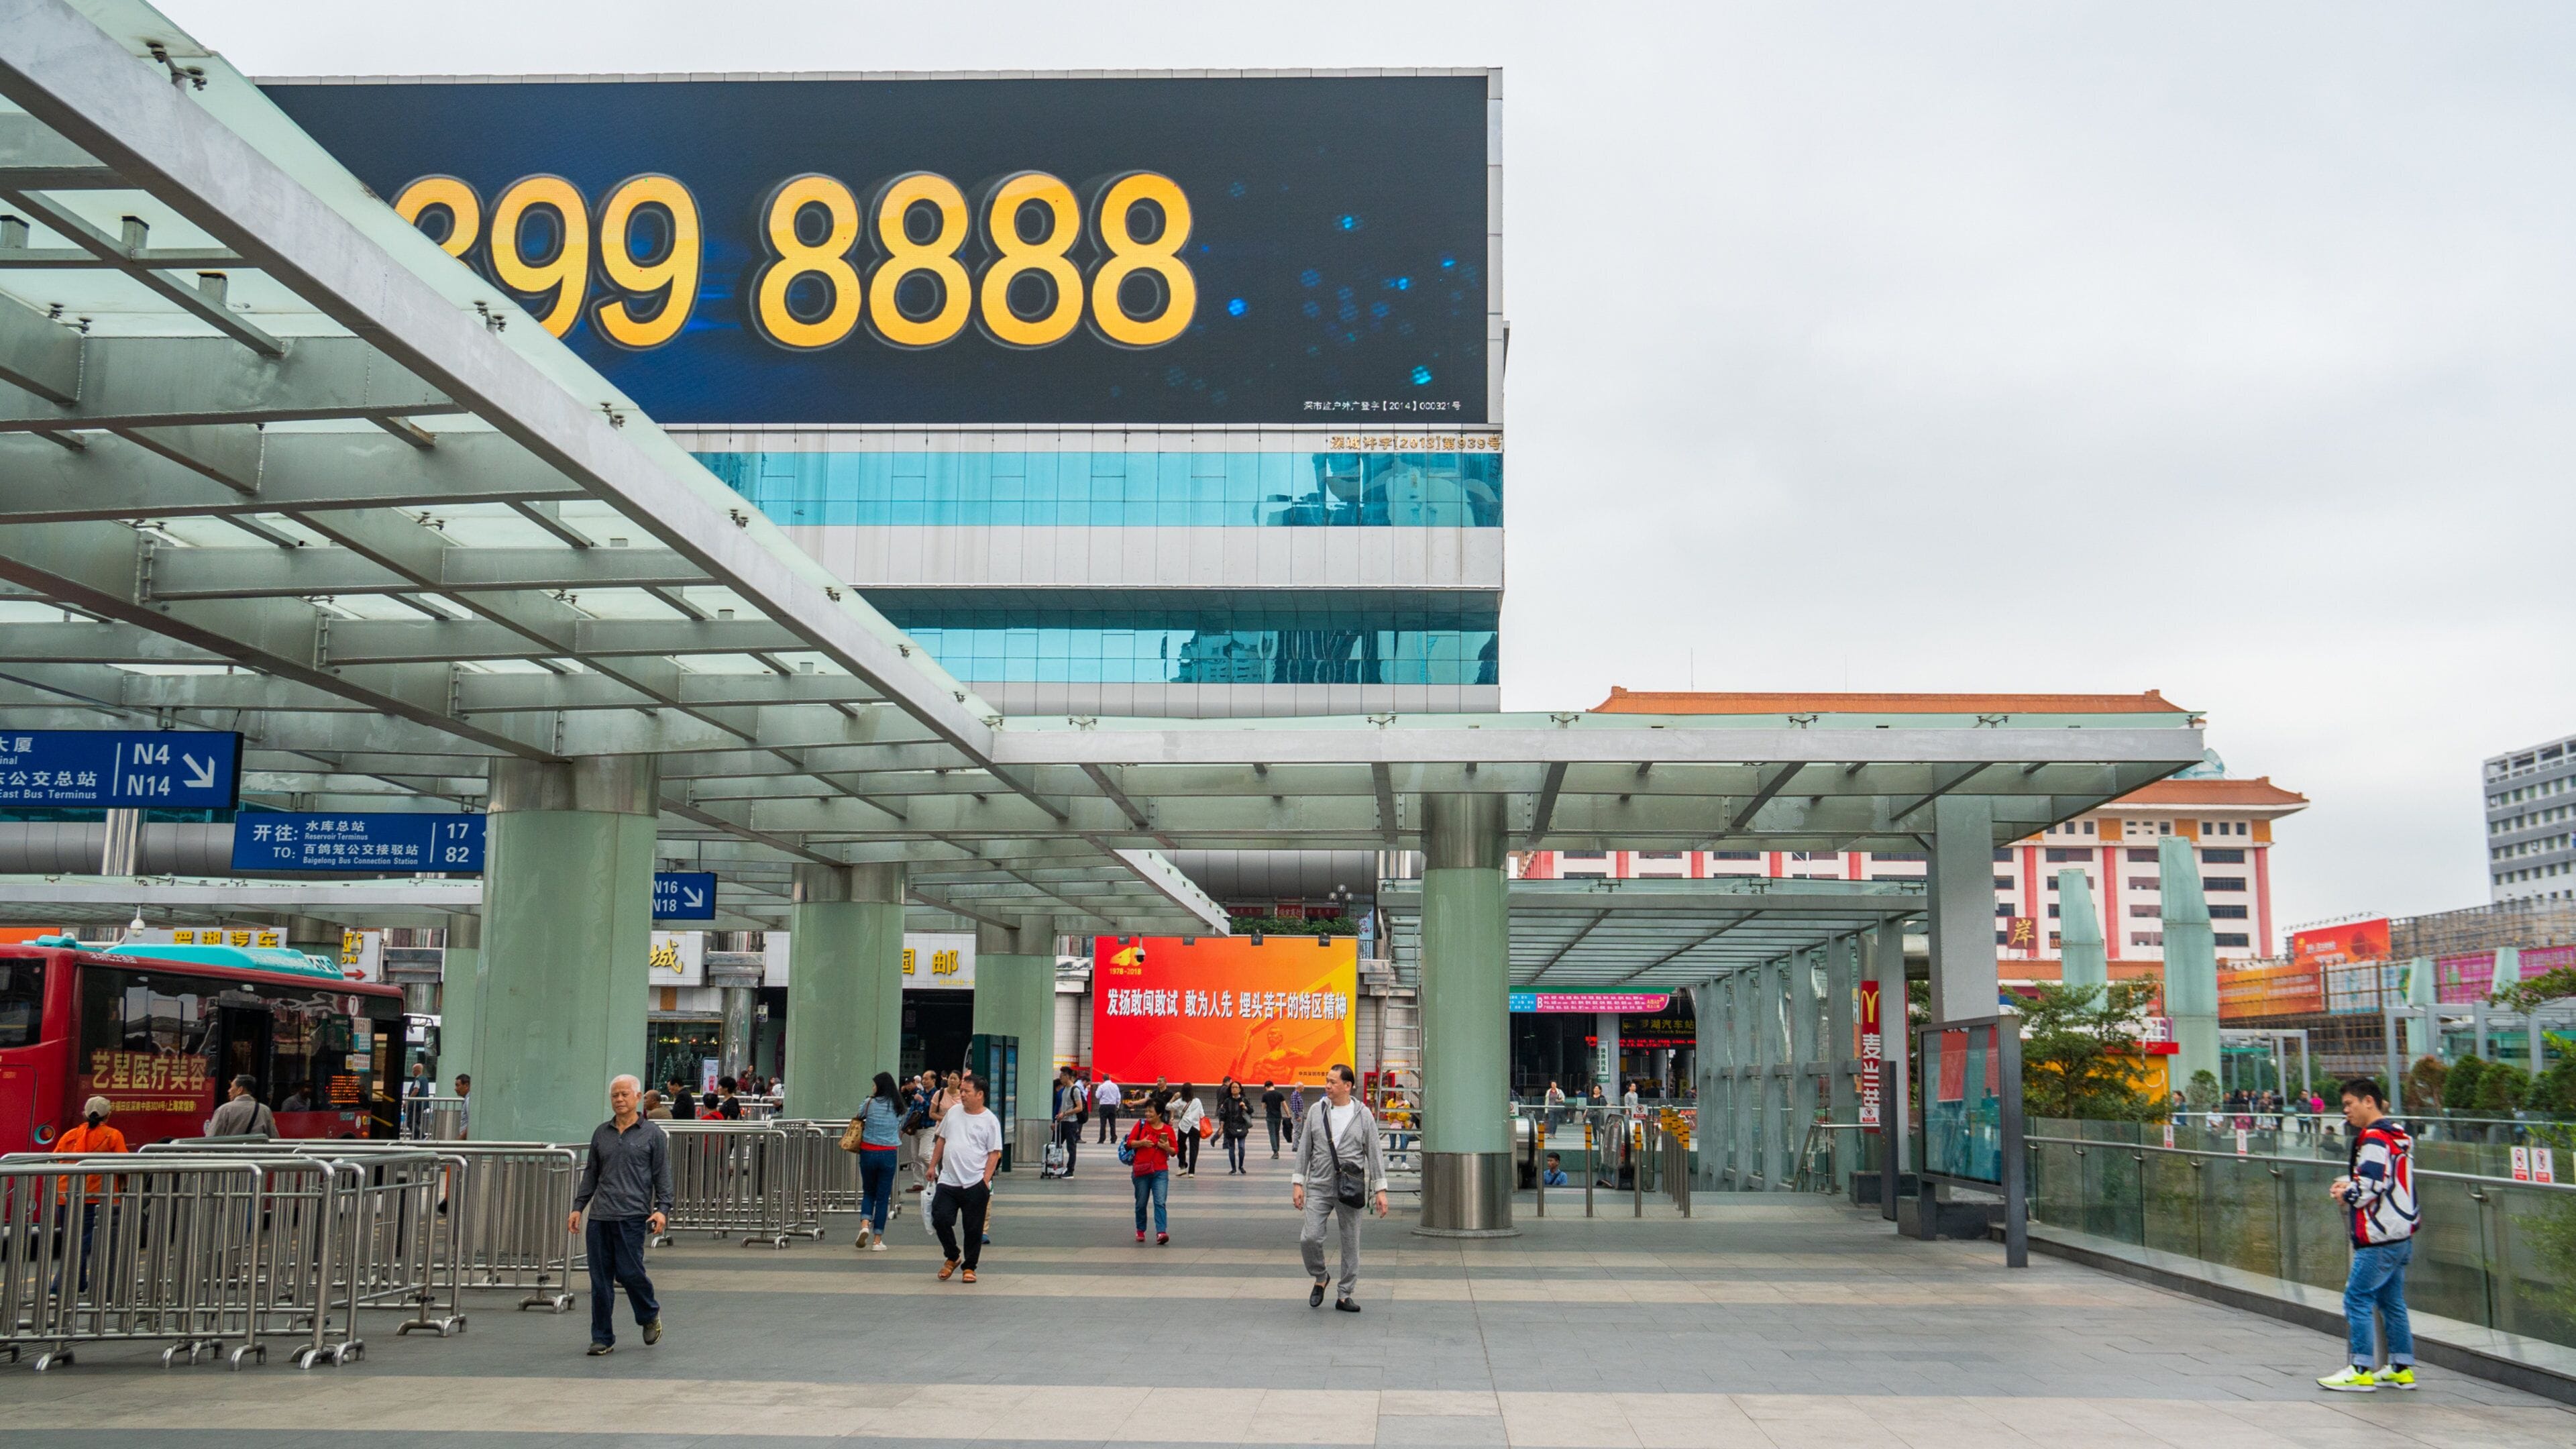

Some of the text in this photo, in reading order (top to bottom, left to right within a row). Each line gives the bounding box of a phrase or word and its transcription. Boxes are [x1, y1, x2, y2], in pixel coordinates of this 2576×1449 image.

[759, 174, 1196, 347] 8888
[133, 743, 170, 765] N4
[127, 775, 170, 796] N14
[23, 790, 43, 799] Bus
[48, 790, 97, 800] Terminus
[305, 820, 365, 832] 水库总站
[446, 823, 469, 839] 17
[305, 833, 368, 841] Reservoir Terminus
[273, 847, 296, 859] TO:
[303, 844, 419, 855] 百鸽笼公交接驳站
[445, 847, 469, 863] 82
[303, 856, 335, 865] Baigelong
[338, 857, 351, 865] Bus
[394, 857, 418, 865] Station
[654, 881, 678, 894] N16
[653, 899, 677, 912] N18
[2010, 918, 2035, 947] 岸
[650, 938, 683, 974] 城
[1107, 988, 1348, 1020] 发扬敢闯敢试 敢为人先 埋头苦干的特区精神
[1537, 997, 1543, 1008] B
[92, 1051, 207, 1091] 艺星医疗美容
